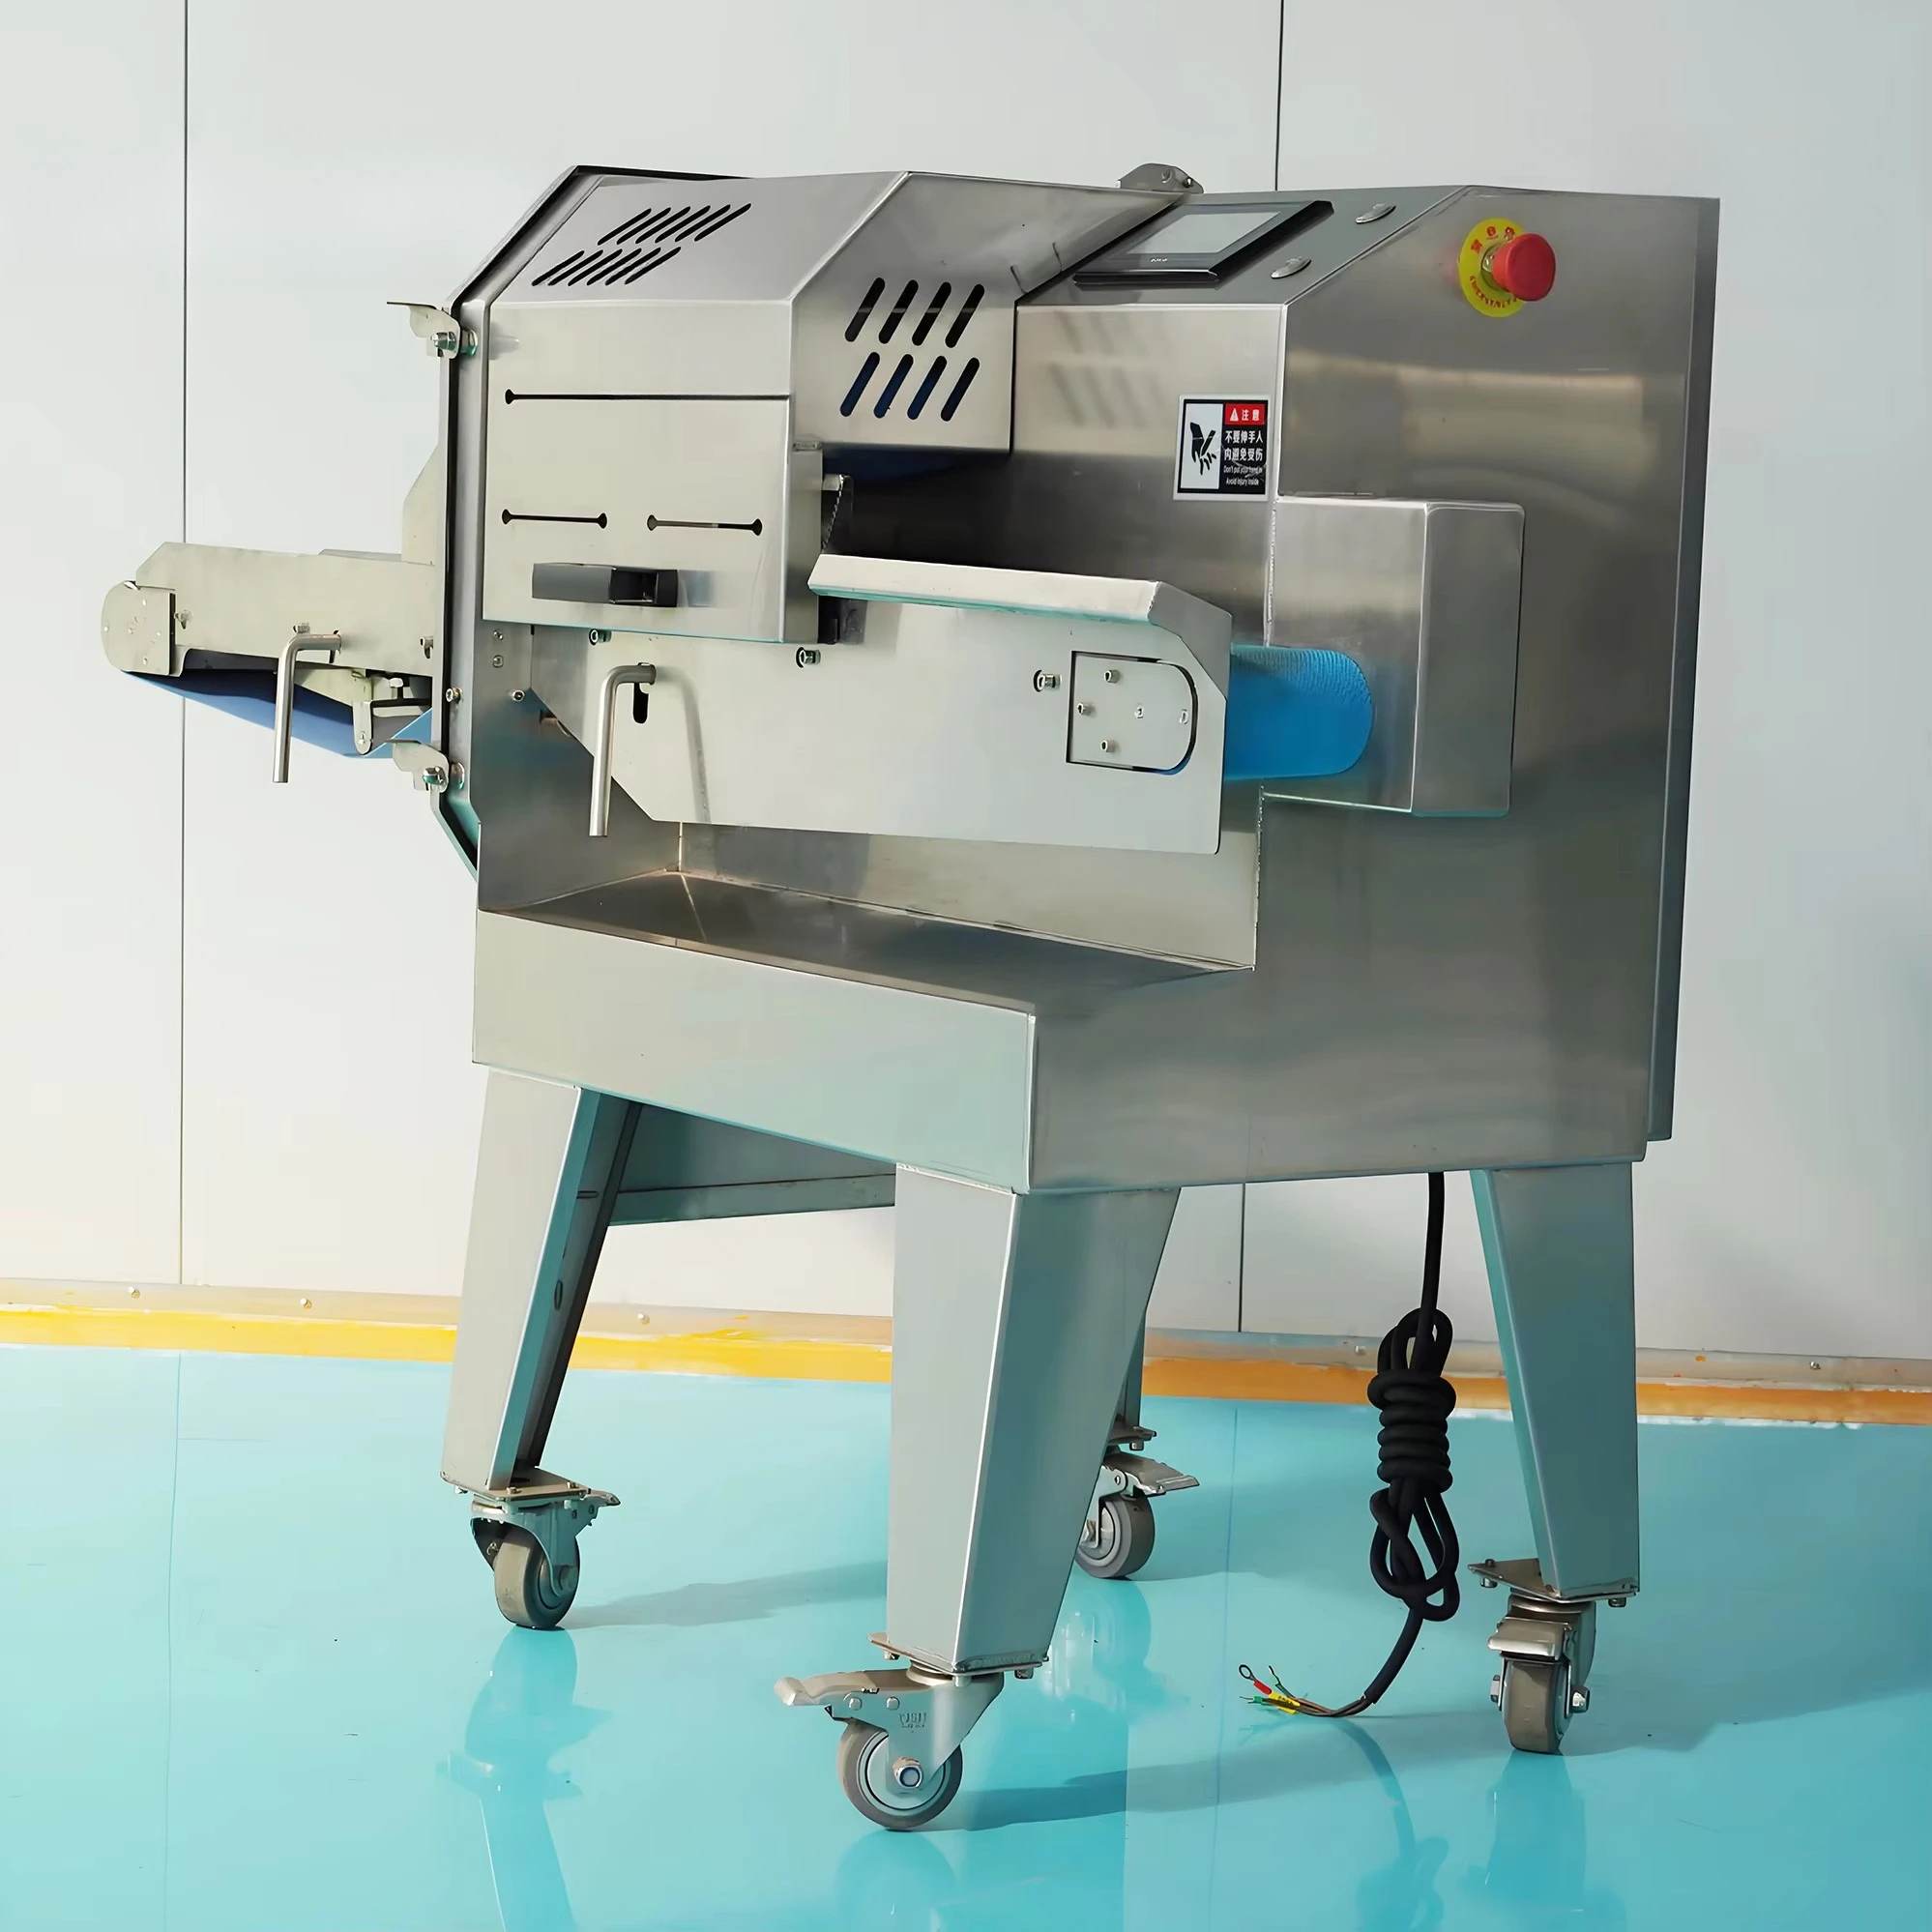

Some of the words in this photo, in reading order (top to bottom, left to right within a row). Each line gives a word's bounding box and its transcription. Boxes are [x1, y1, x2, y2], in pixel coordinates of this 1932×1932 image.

[1242, 409, 1260, 422] 注意
[1223, 448, 1263, 461] 内避免受伤
[1238, 478, 1247, 486] injury
